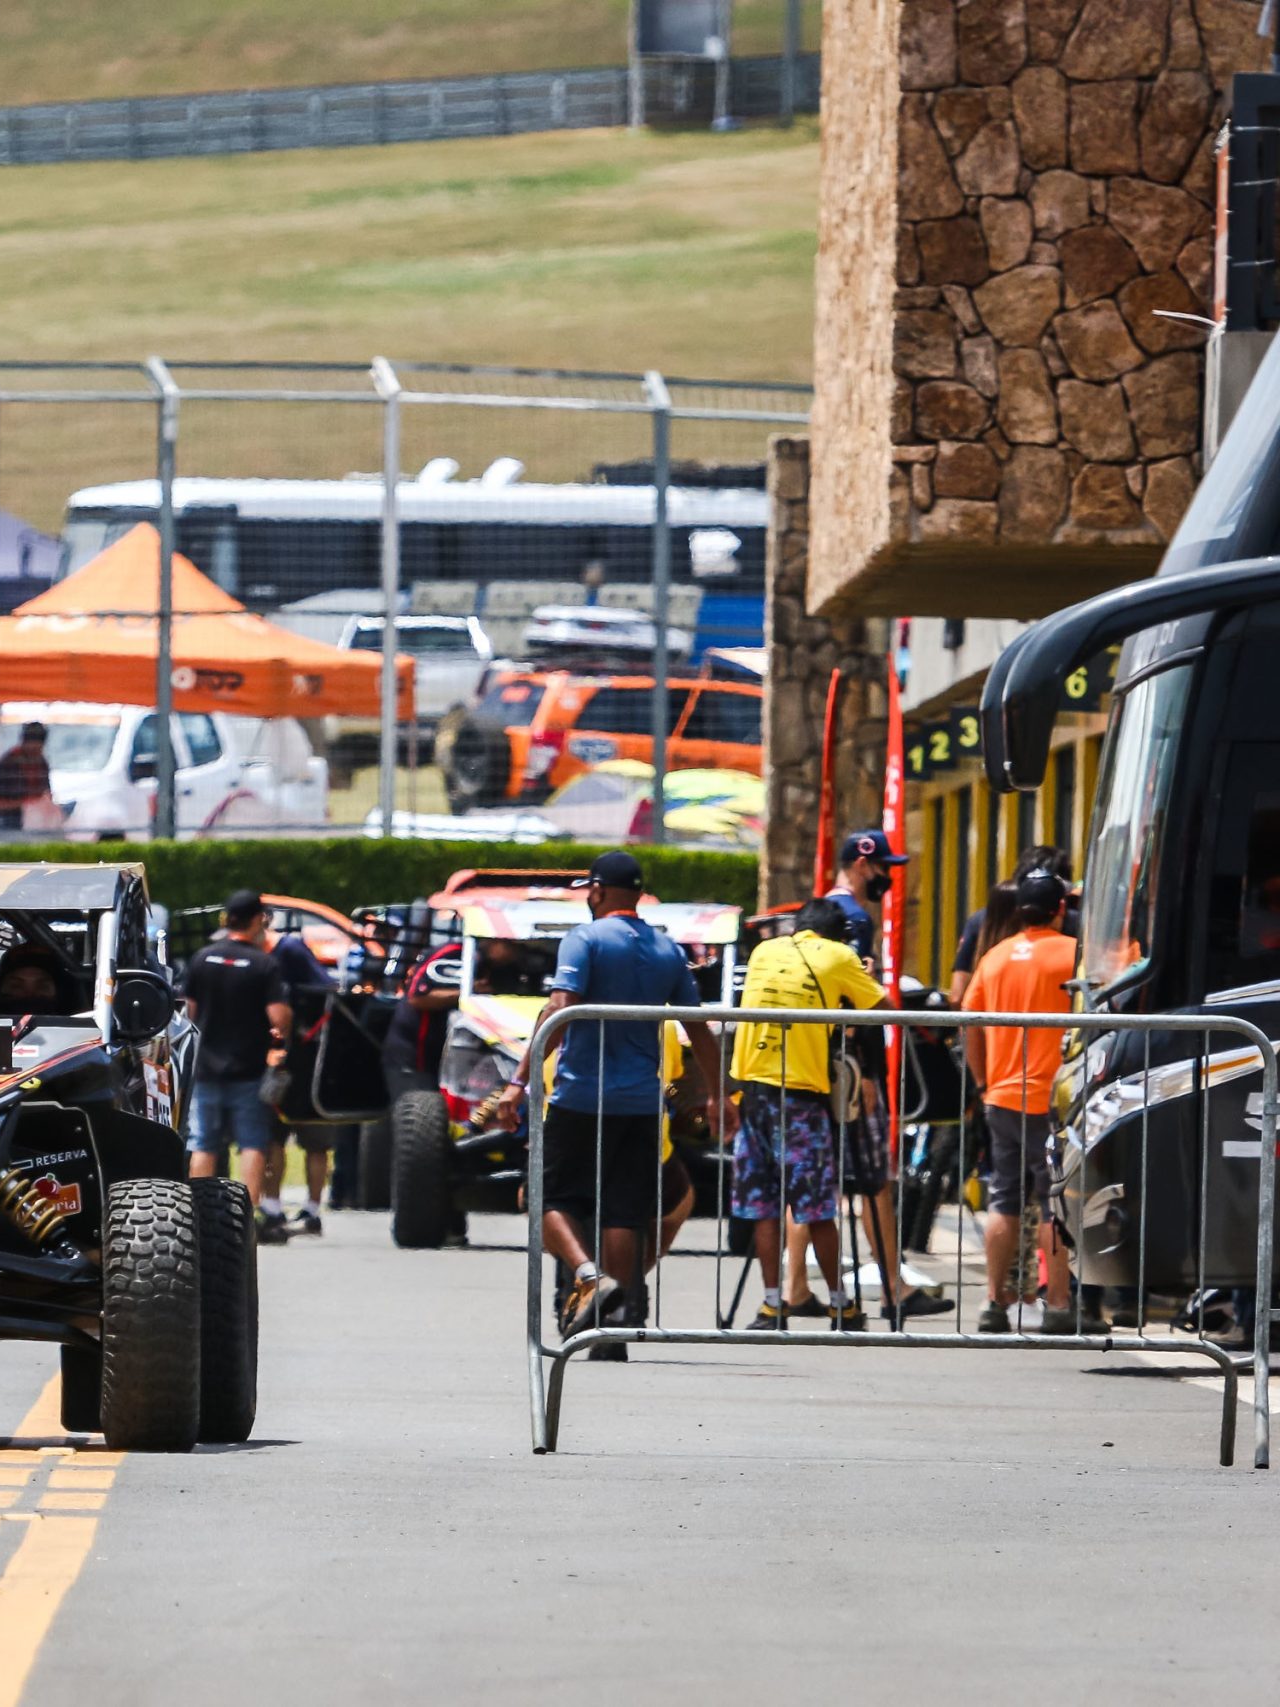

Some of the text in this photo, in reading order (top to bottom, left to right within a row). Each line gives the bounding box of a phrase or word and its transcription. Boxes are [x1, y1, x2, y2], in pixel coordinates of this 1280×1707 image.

[1064, 665, 1089, 700] 6
[929, 730, 950, 762] 2
[958, 715, 979, 748] 3
[908, 745, 924, 773] 1
[35, 1149, 88, 1168] RESERVA
